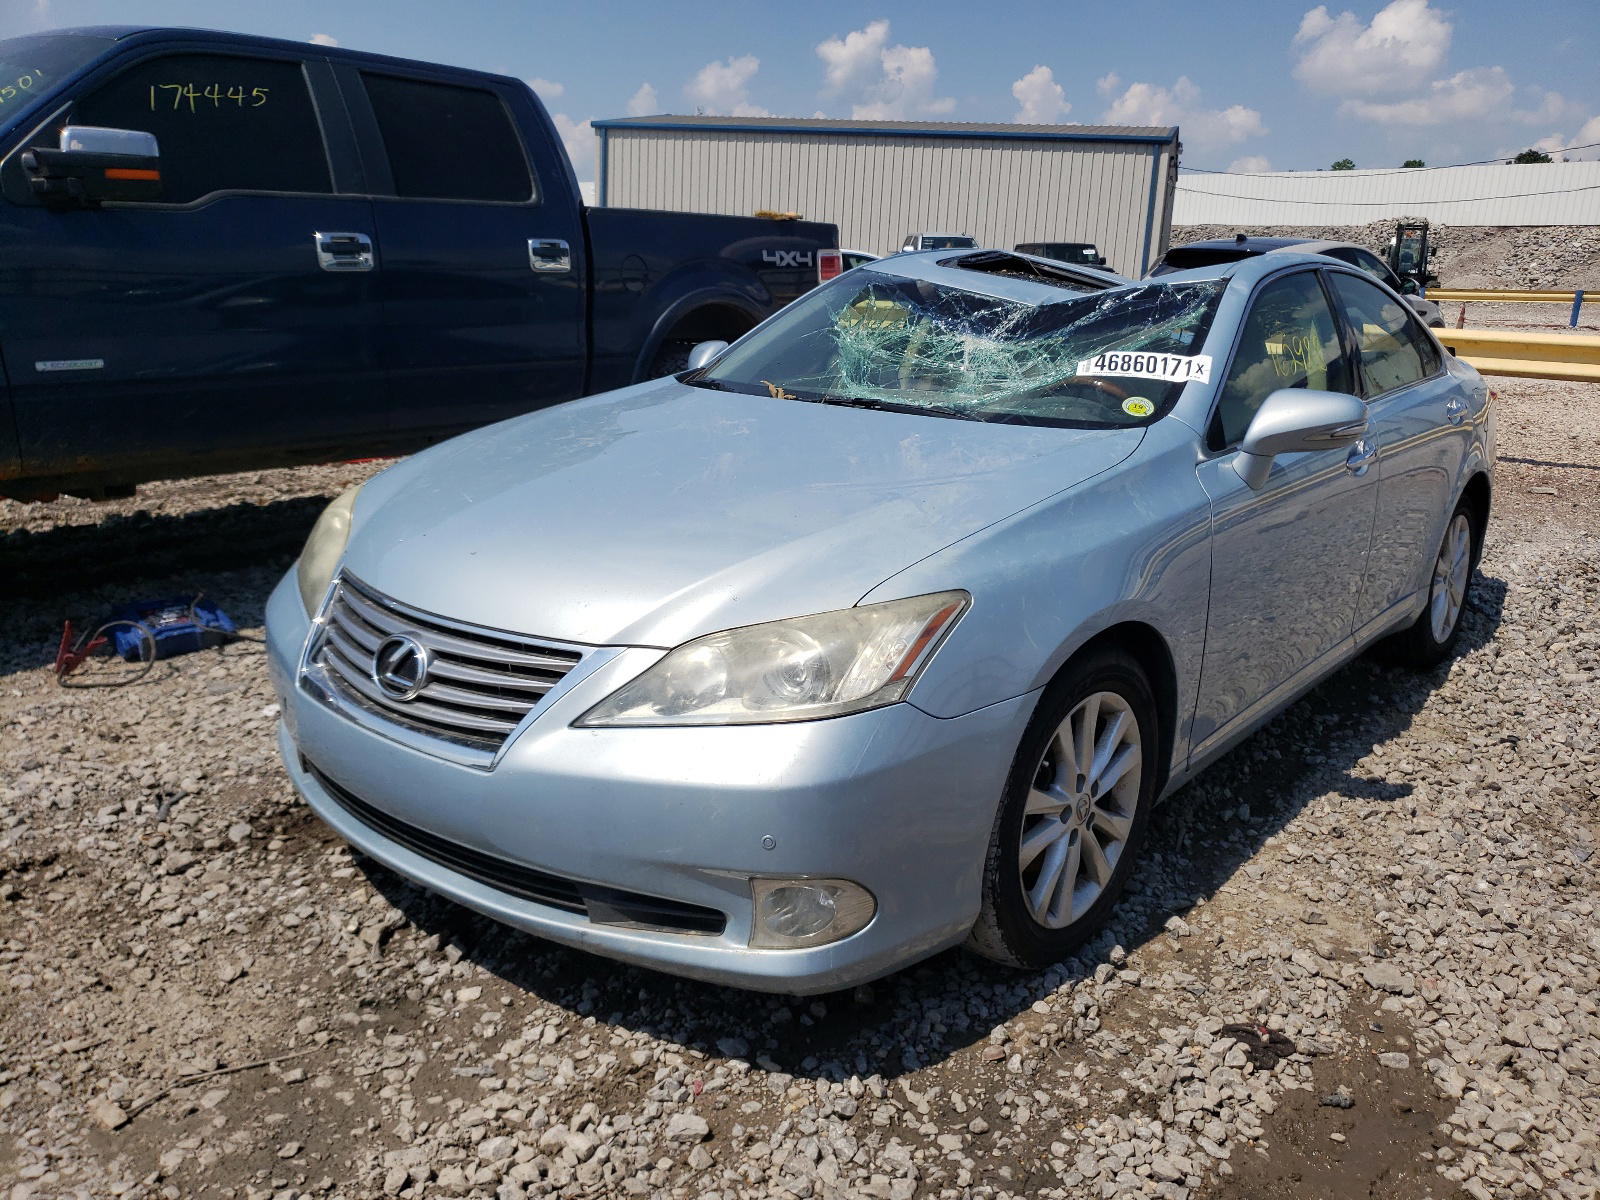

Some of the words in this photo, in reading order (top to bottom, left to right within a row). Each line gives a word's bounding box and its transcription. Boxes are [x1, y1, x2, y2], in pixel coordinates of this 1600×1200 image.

[150, 83, 270, 113] 174445
[762, 249, 813, 267] 4X4
[1094, 354, 1193, 377] 46860171
